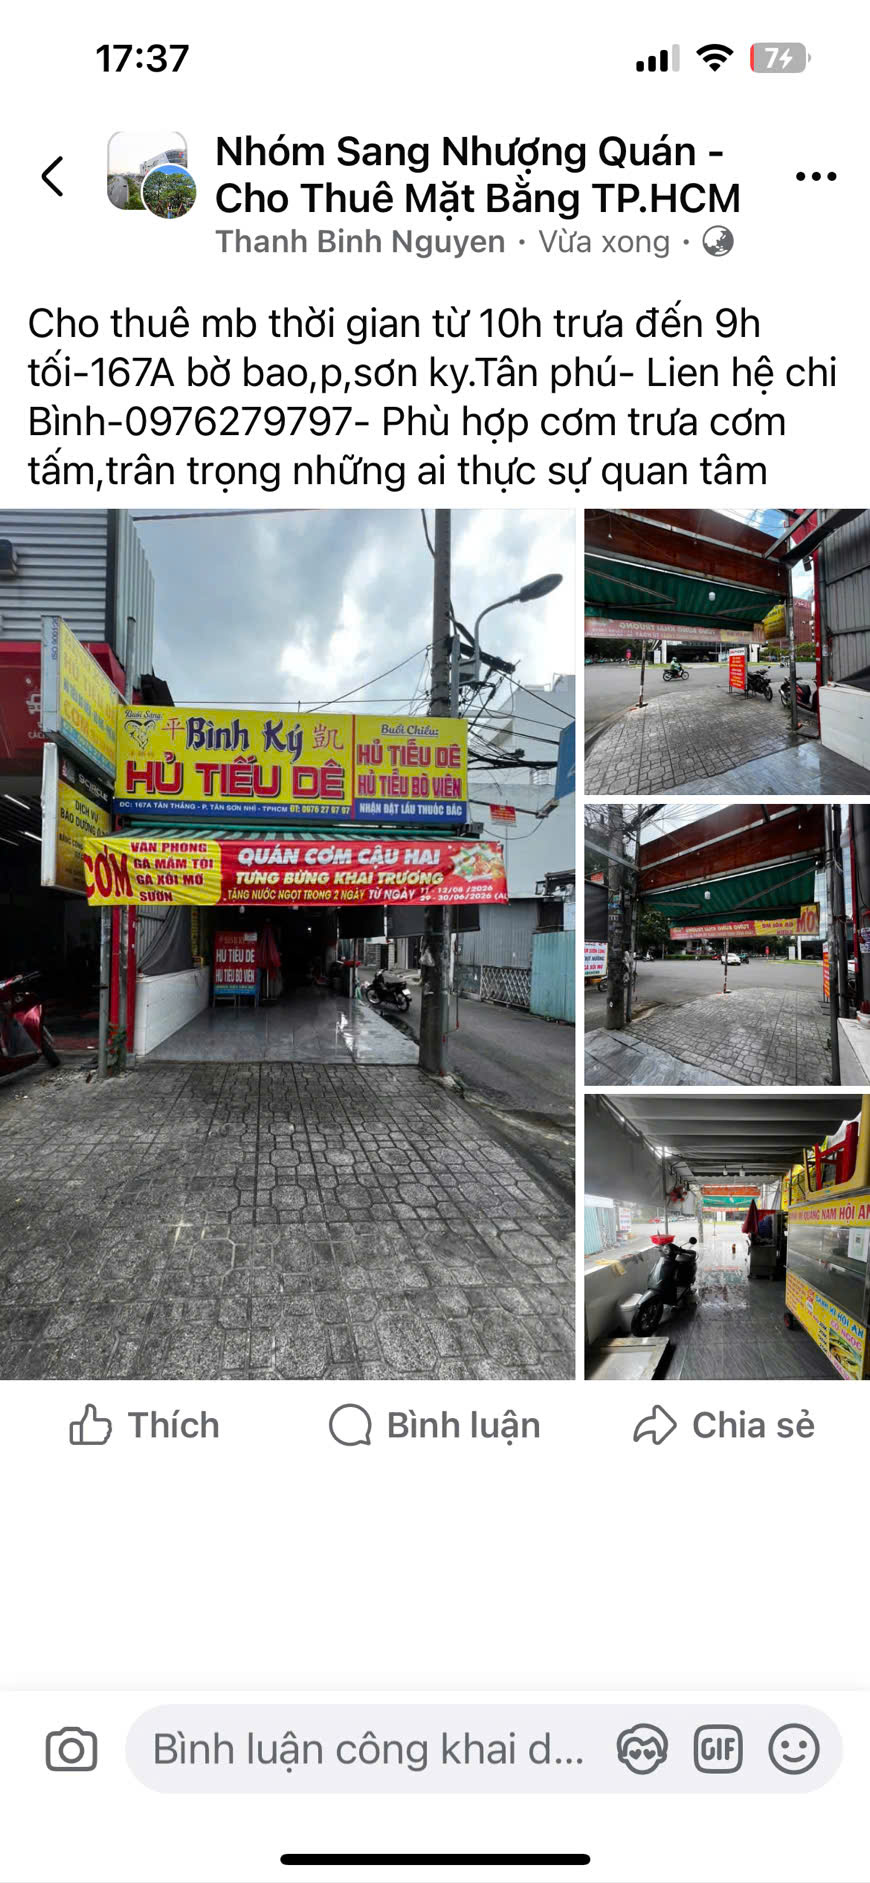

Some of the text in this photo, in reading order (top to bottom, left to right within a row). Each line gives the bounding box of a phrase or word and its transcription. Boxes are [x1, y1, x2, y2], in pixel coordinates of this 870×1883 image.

[186, 717, 303, 764] Bình Ký
[357, 738, 461, 768] HỦ TIẾU DÊ
[126, 752, 183, 795] HỦ
[195, 755, 281, 798] TIẾU
[292, 758, 345, 800] DÊ
[357, 767, 462, 799] HỦ TIẾU BÒ VIÊN
[359, 802, 381, 816] NHẬN
[238, 844, 440, 869] QUÁN CƠM CẬU HAI
[284, 869, 330, 885] BỪNG
[334, 871, 373, 884] KHAI
[378, 870, 444, 885] TRƯƠNG
[228, 887, 415, 902] TẶNG NƯỚC NGỌT TRONG 2 NGÀY TỪ NGÀY
[822, 1207, 837, 1219] NAM
[840, 1202, 855, 1224] HỘI
